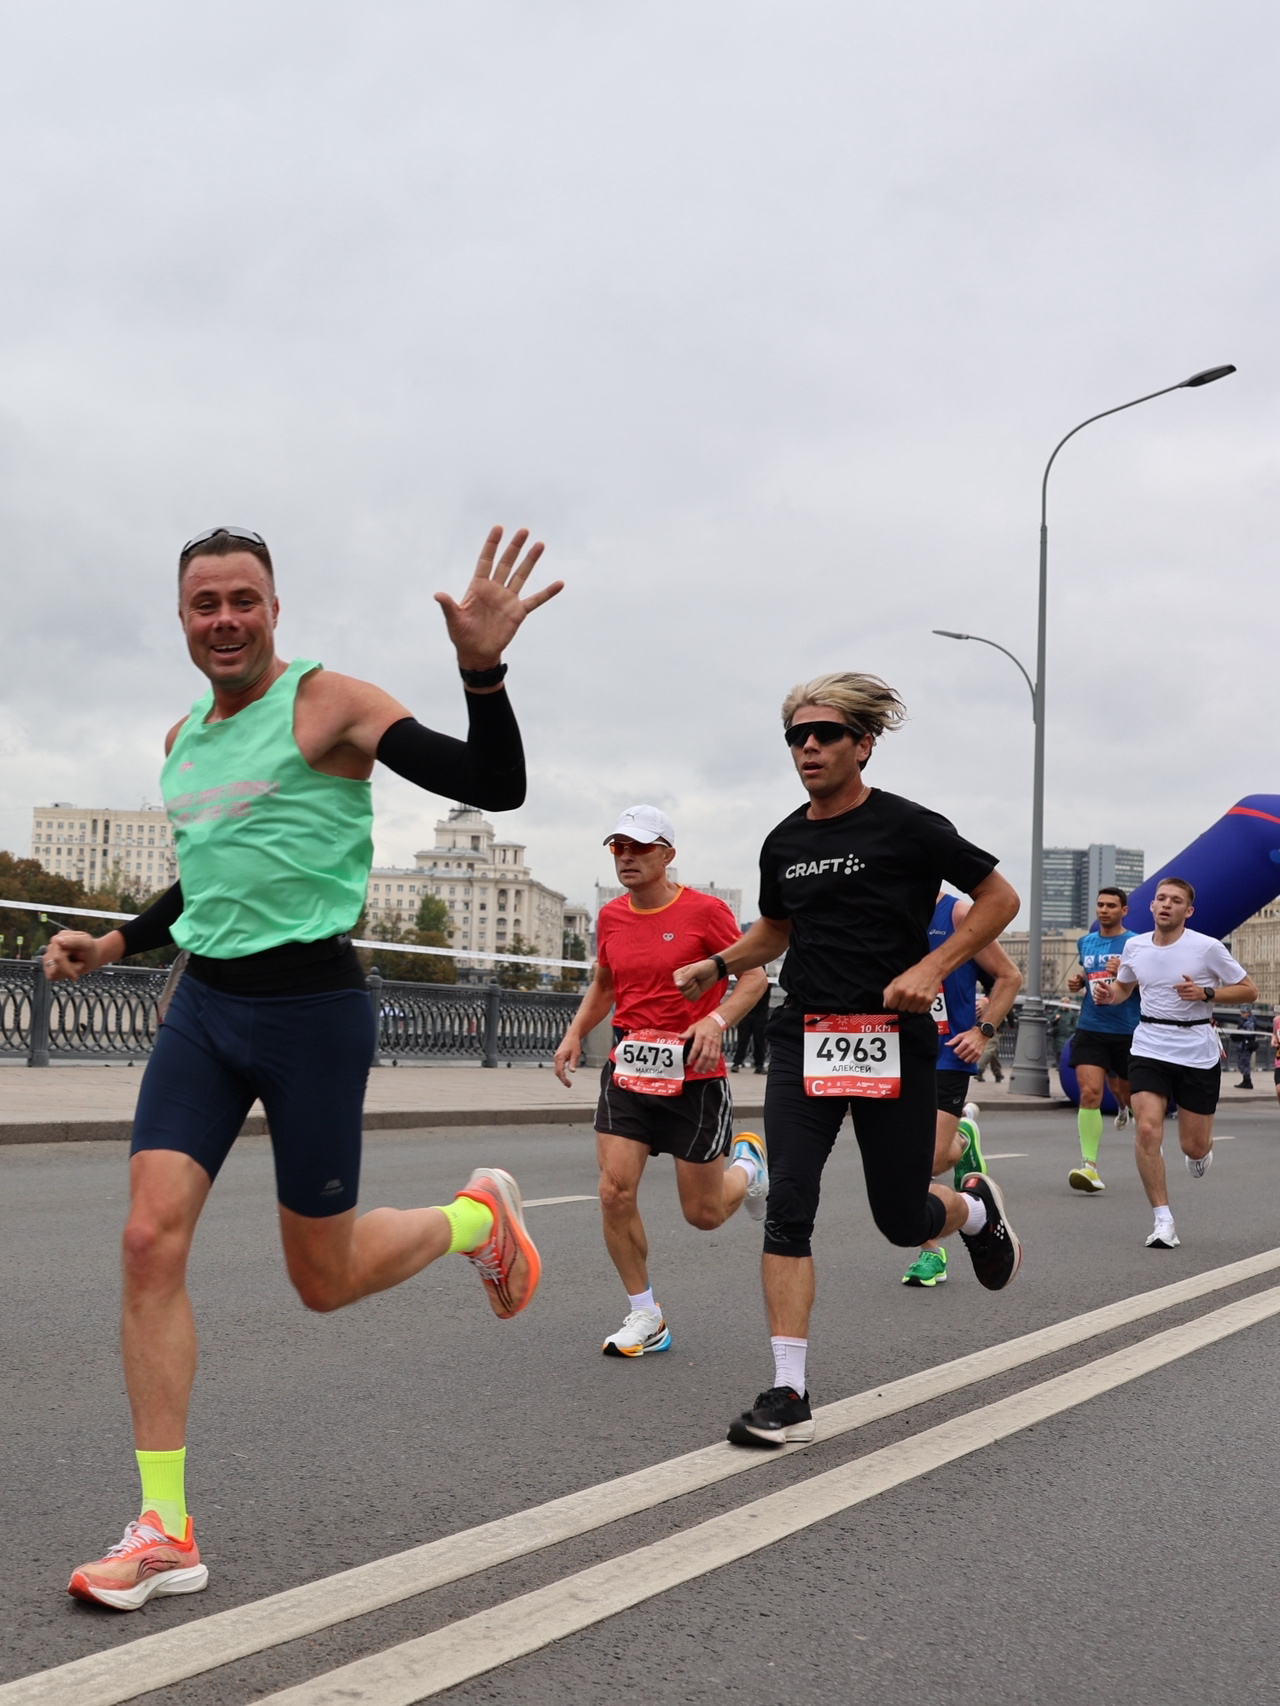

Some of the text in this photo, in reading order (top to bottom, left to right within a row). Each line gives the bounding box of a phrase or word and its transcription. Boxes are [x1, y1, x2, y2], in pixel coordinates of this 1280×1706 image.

[785, 858, 844, 879] CRAFT
[860, 1024, 872, 1033] 10
[656, 1036, 667, 1045] 10
[816, 1036, 887, 1062] 4963
[623, 1044, 674, 1068] 5473
[635, 1067, 663, 1075] МАКСИМ
[831, 1064, 872, 1074] АЛЕКСЕЙ
